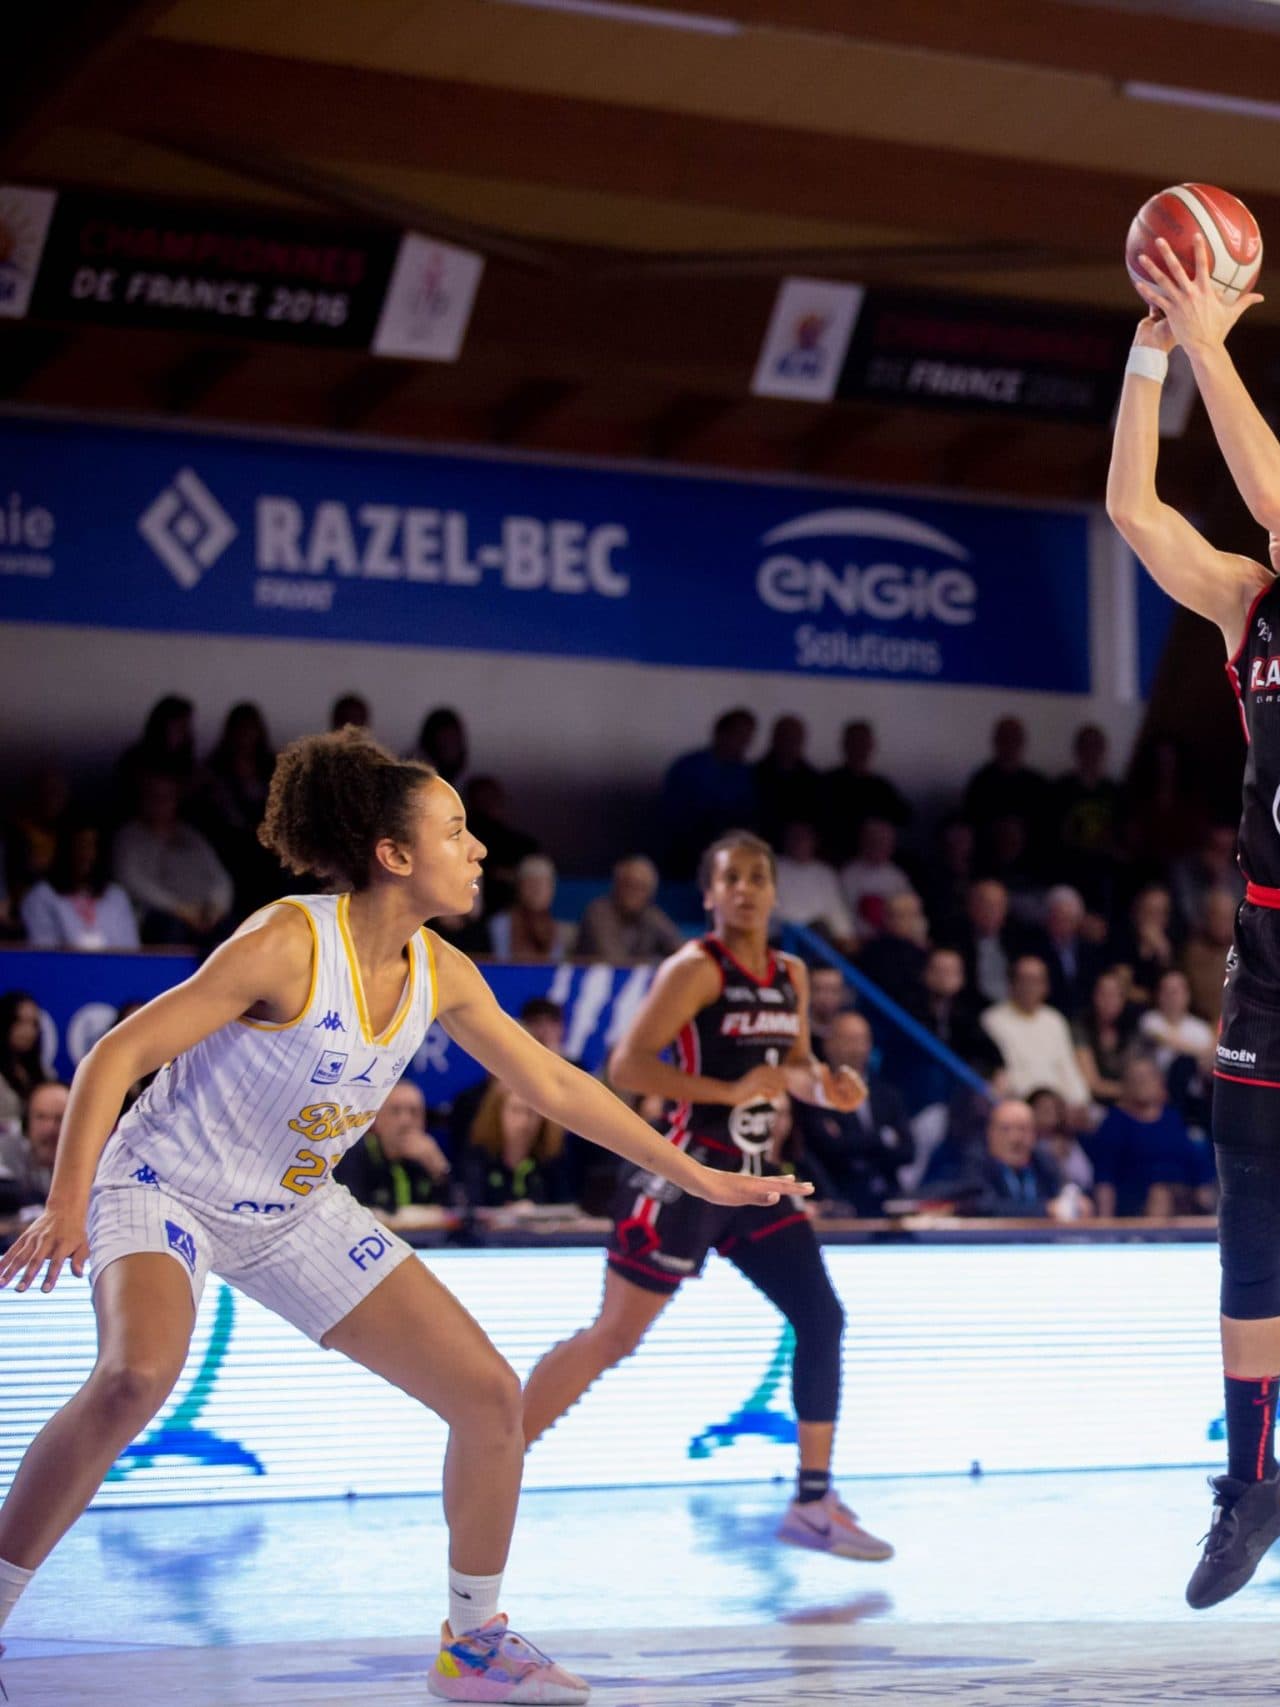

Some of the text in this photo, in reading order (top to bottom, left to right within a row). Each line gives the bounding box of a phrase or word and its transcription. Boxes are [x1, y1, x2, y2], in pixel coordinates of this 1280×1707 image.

[70, 265, 118, 301] DE
[124, 271, 260, 318] FRANCE
[0, 491, 55, 549] ie
[256, 494, 630, 597] RAZEL-BEC
